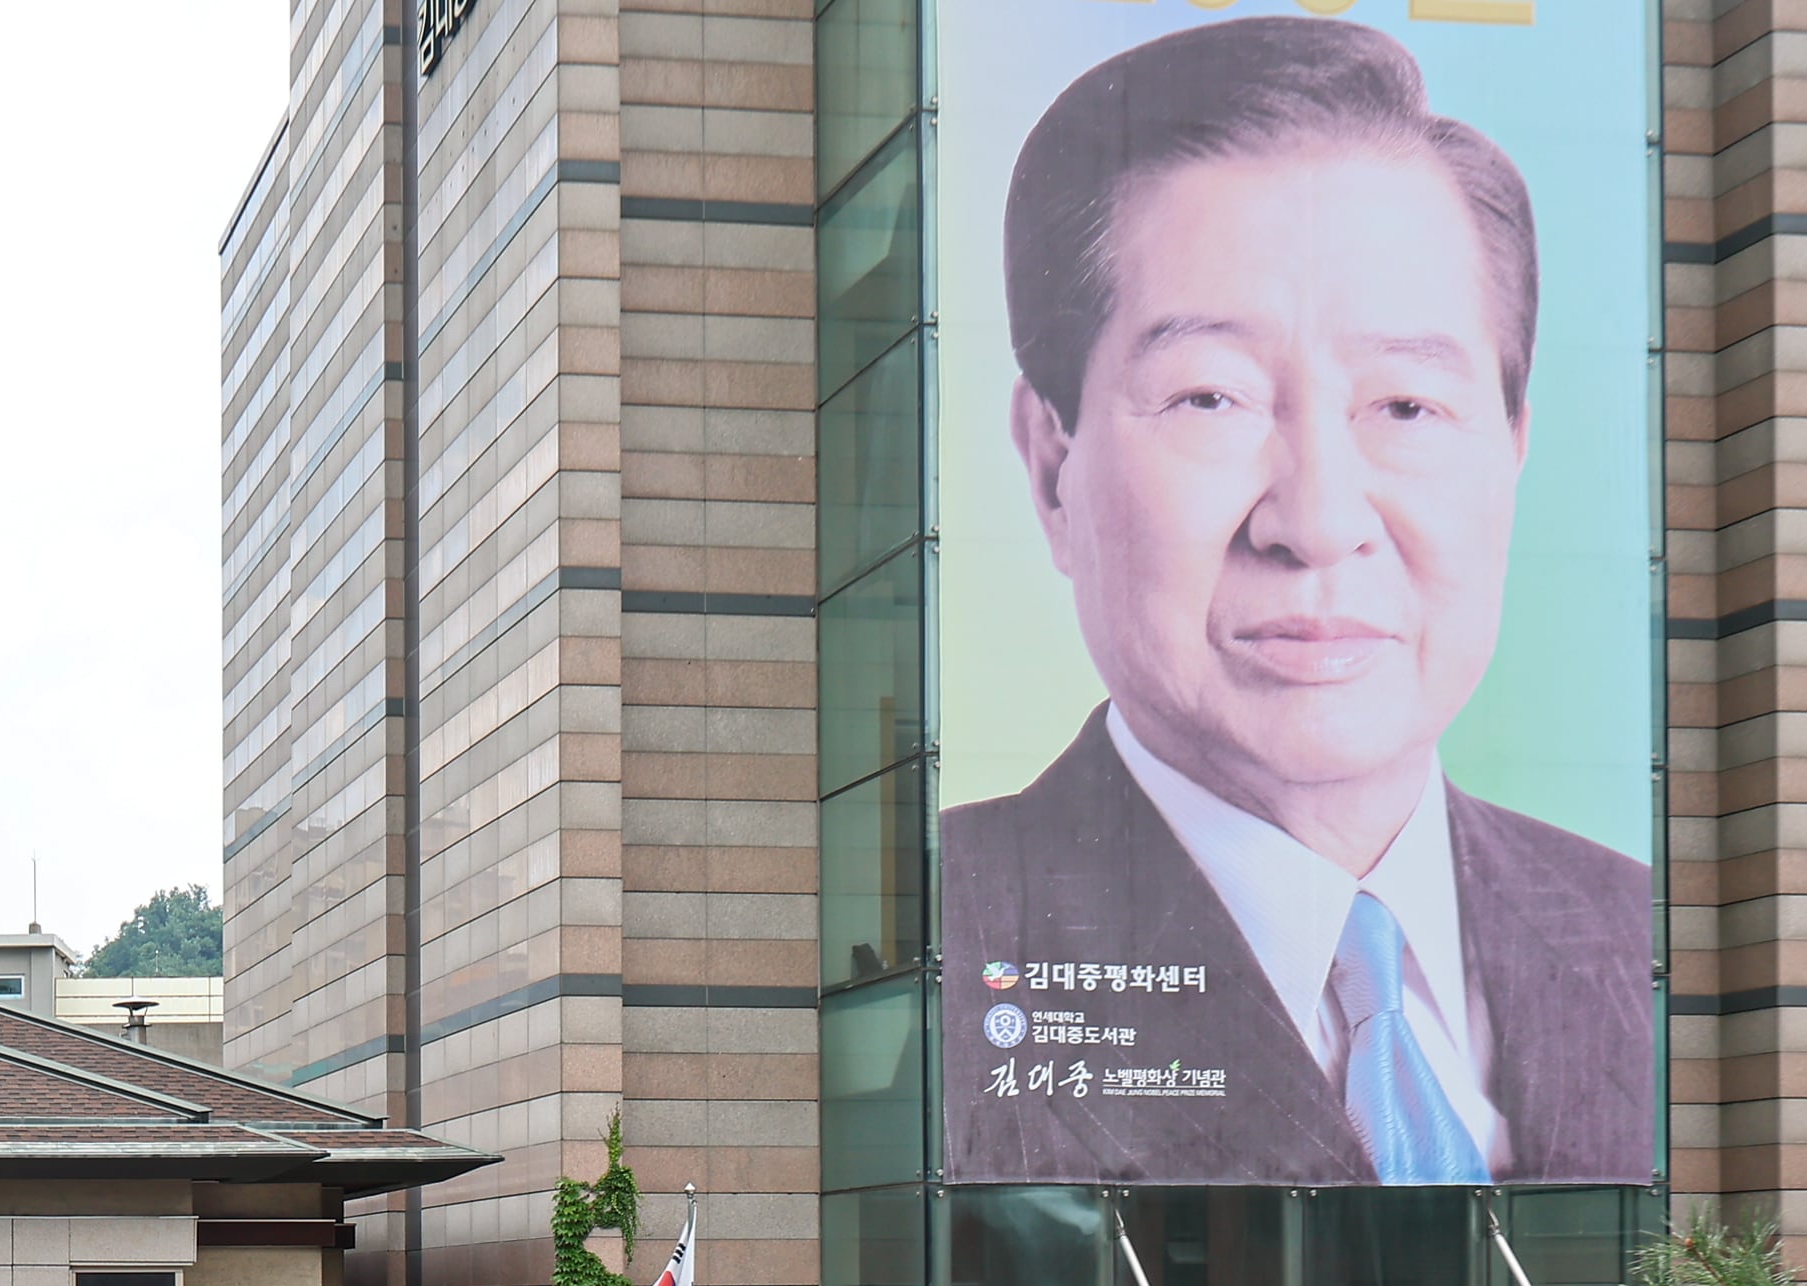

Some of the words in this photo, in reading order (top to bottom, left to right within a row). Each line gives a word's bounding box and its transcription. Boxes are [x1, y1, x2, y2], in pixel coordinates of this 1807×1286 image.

[1024, 962, 1206, 993] 김대중평화센터
[1031, 1010, 1085, 1024] 연세대학교
[1032, 1025, 1137, 1046] 김대중도서관
[1102, 1067, 1179, 1088] 노벨평화상
[1181, 1068, 1227, 1088] 기념관
